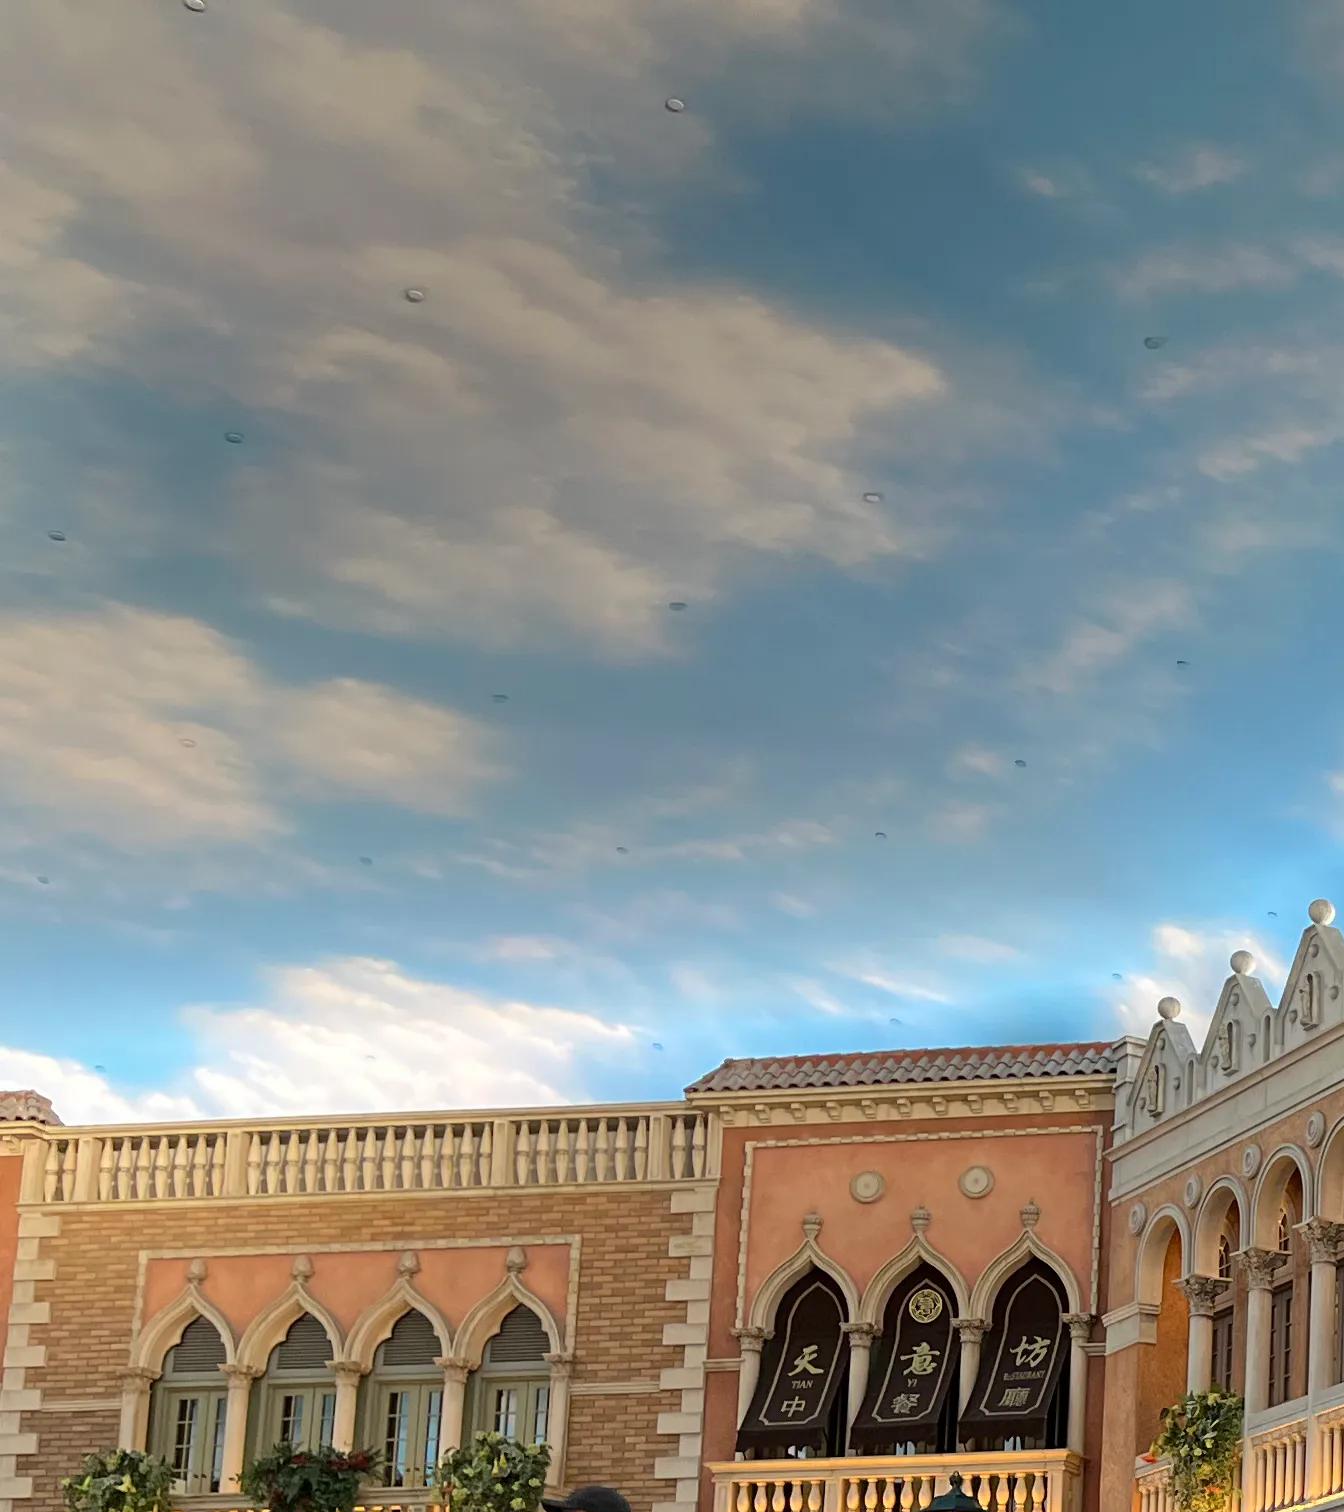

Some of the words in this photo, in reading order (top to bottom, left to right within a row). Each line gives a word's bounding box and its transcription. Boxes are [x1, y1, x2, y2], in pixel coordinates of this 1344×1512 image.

[787, 1344, 824, 1376] 天
[900, 1341, 940, 1376] 意
[1010, 1335, 1051, 1368] 坊
[791, 1380, 814, 1389] TIAN
[907, 1378, 918, 1387] YI
[780, 1396, 806, 1417] 中
